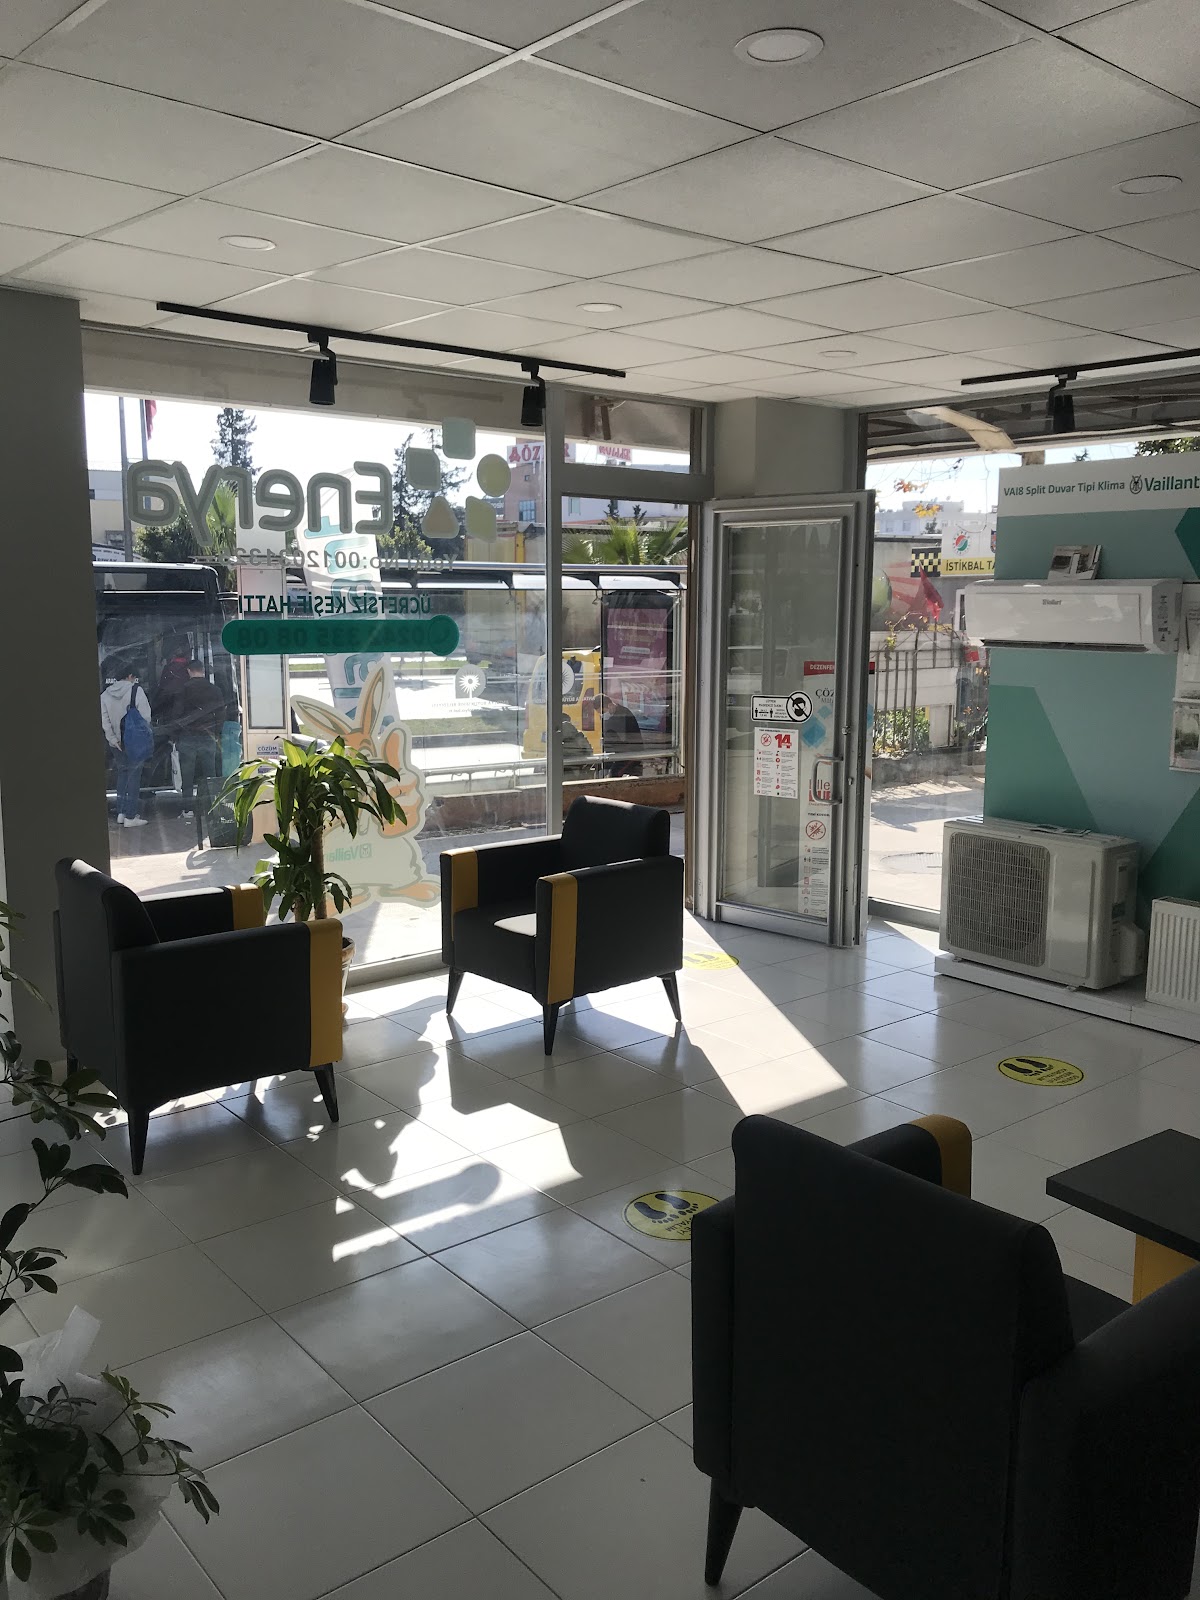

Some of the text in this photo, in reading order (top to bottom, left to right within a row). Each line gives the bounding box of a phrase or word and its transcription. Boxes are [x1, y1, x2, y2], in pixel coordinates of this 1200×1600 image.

[1026, 485, 1046, 498] Split
[1048, 483, 1076, 494] Duvar
[1077, 481, 1096, 494] Tipi
[1098, 480, 1125, 491] Klima
[1144, 475, 1200, 492] Vaillant
[945, 559, 985, 571] İSTİKBAL
[774, 733, 792, 749] 14
